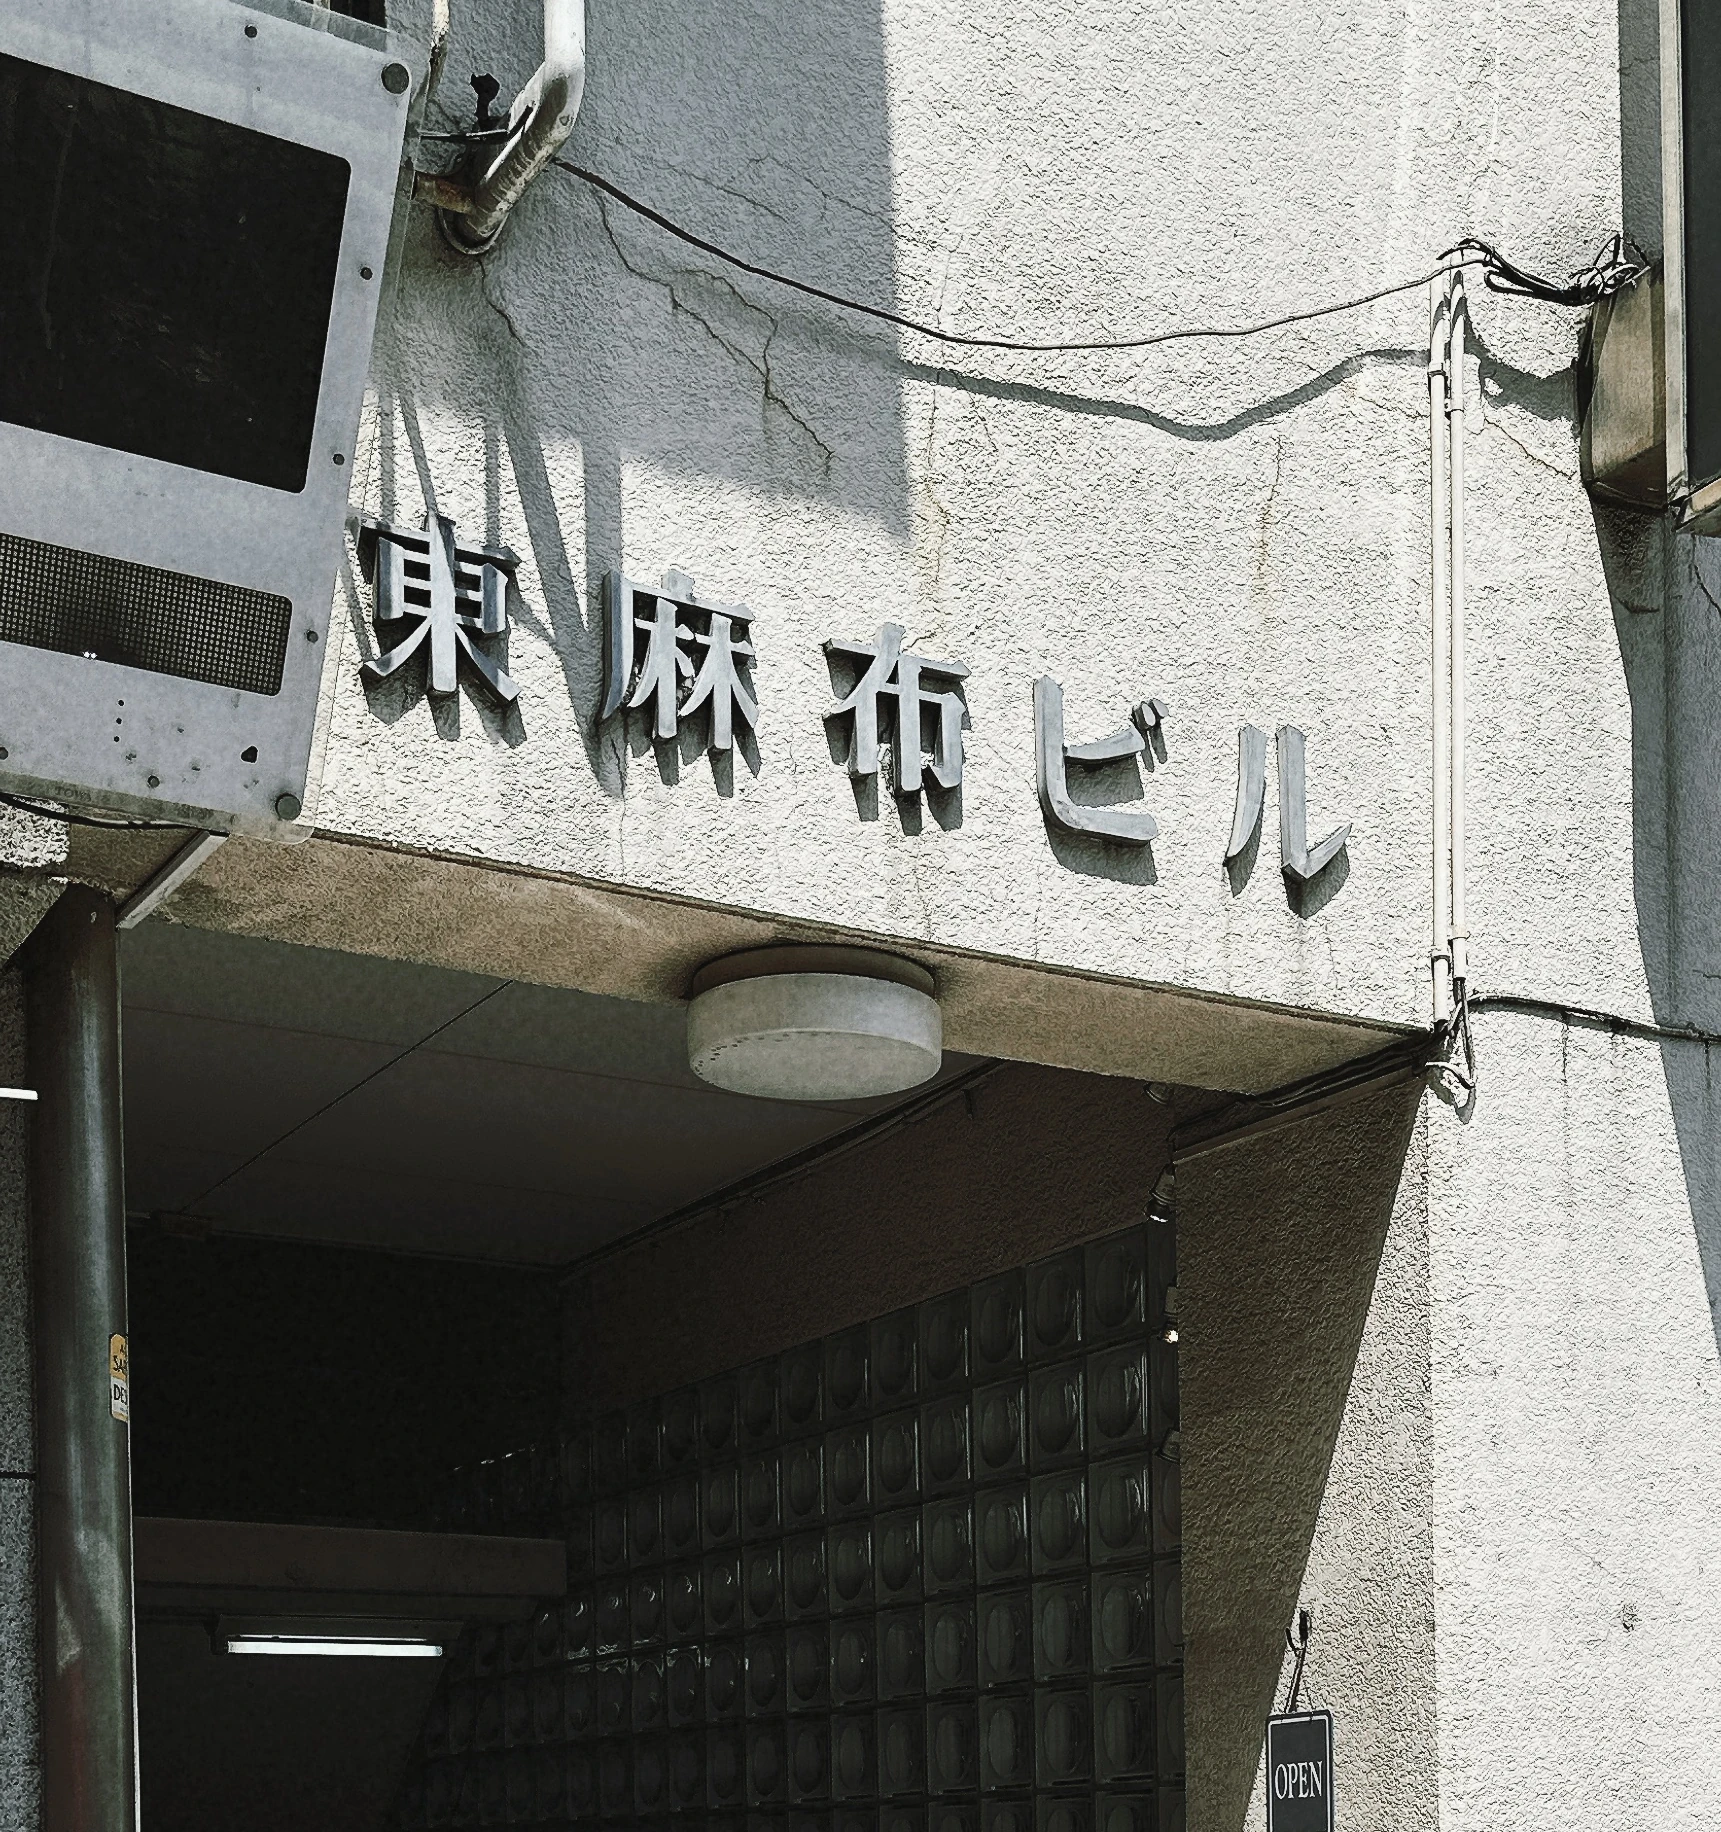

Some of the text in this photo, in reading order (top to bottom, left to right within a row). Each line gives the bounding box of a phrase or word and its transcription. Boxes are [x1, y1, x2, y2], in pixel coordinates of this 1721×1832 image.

[348, 512, 1352, 880] 東麻布ビル
[1275, 1760, 1323, 1800] OPEN
